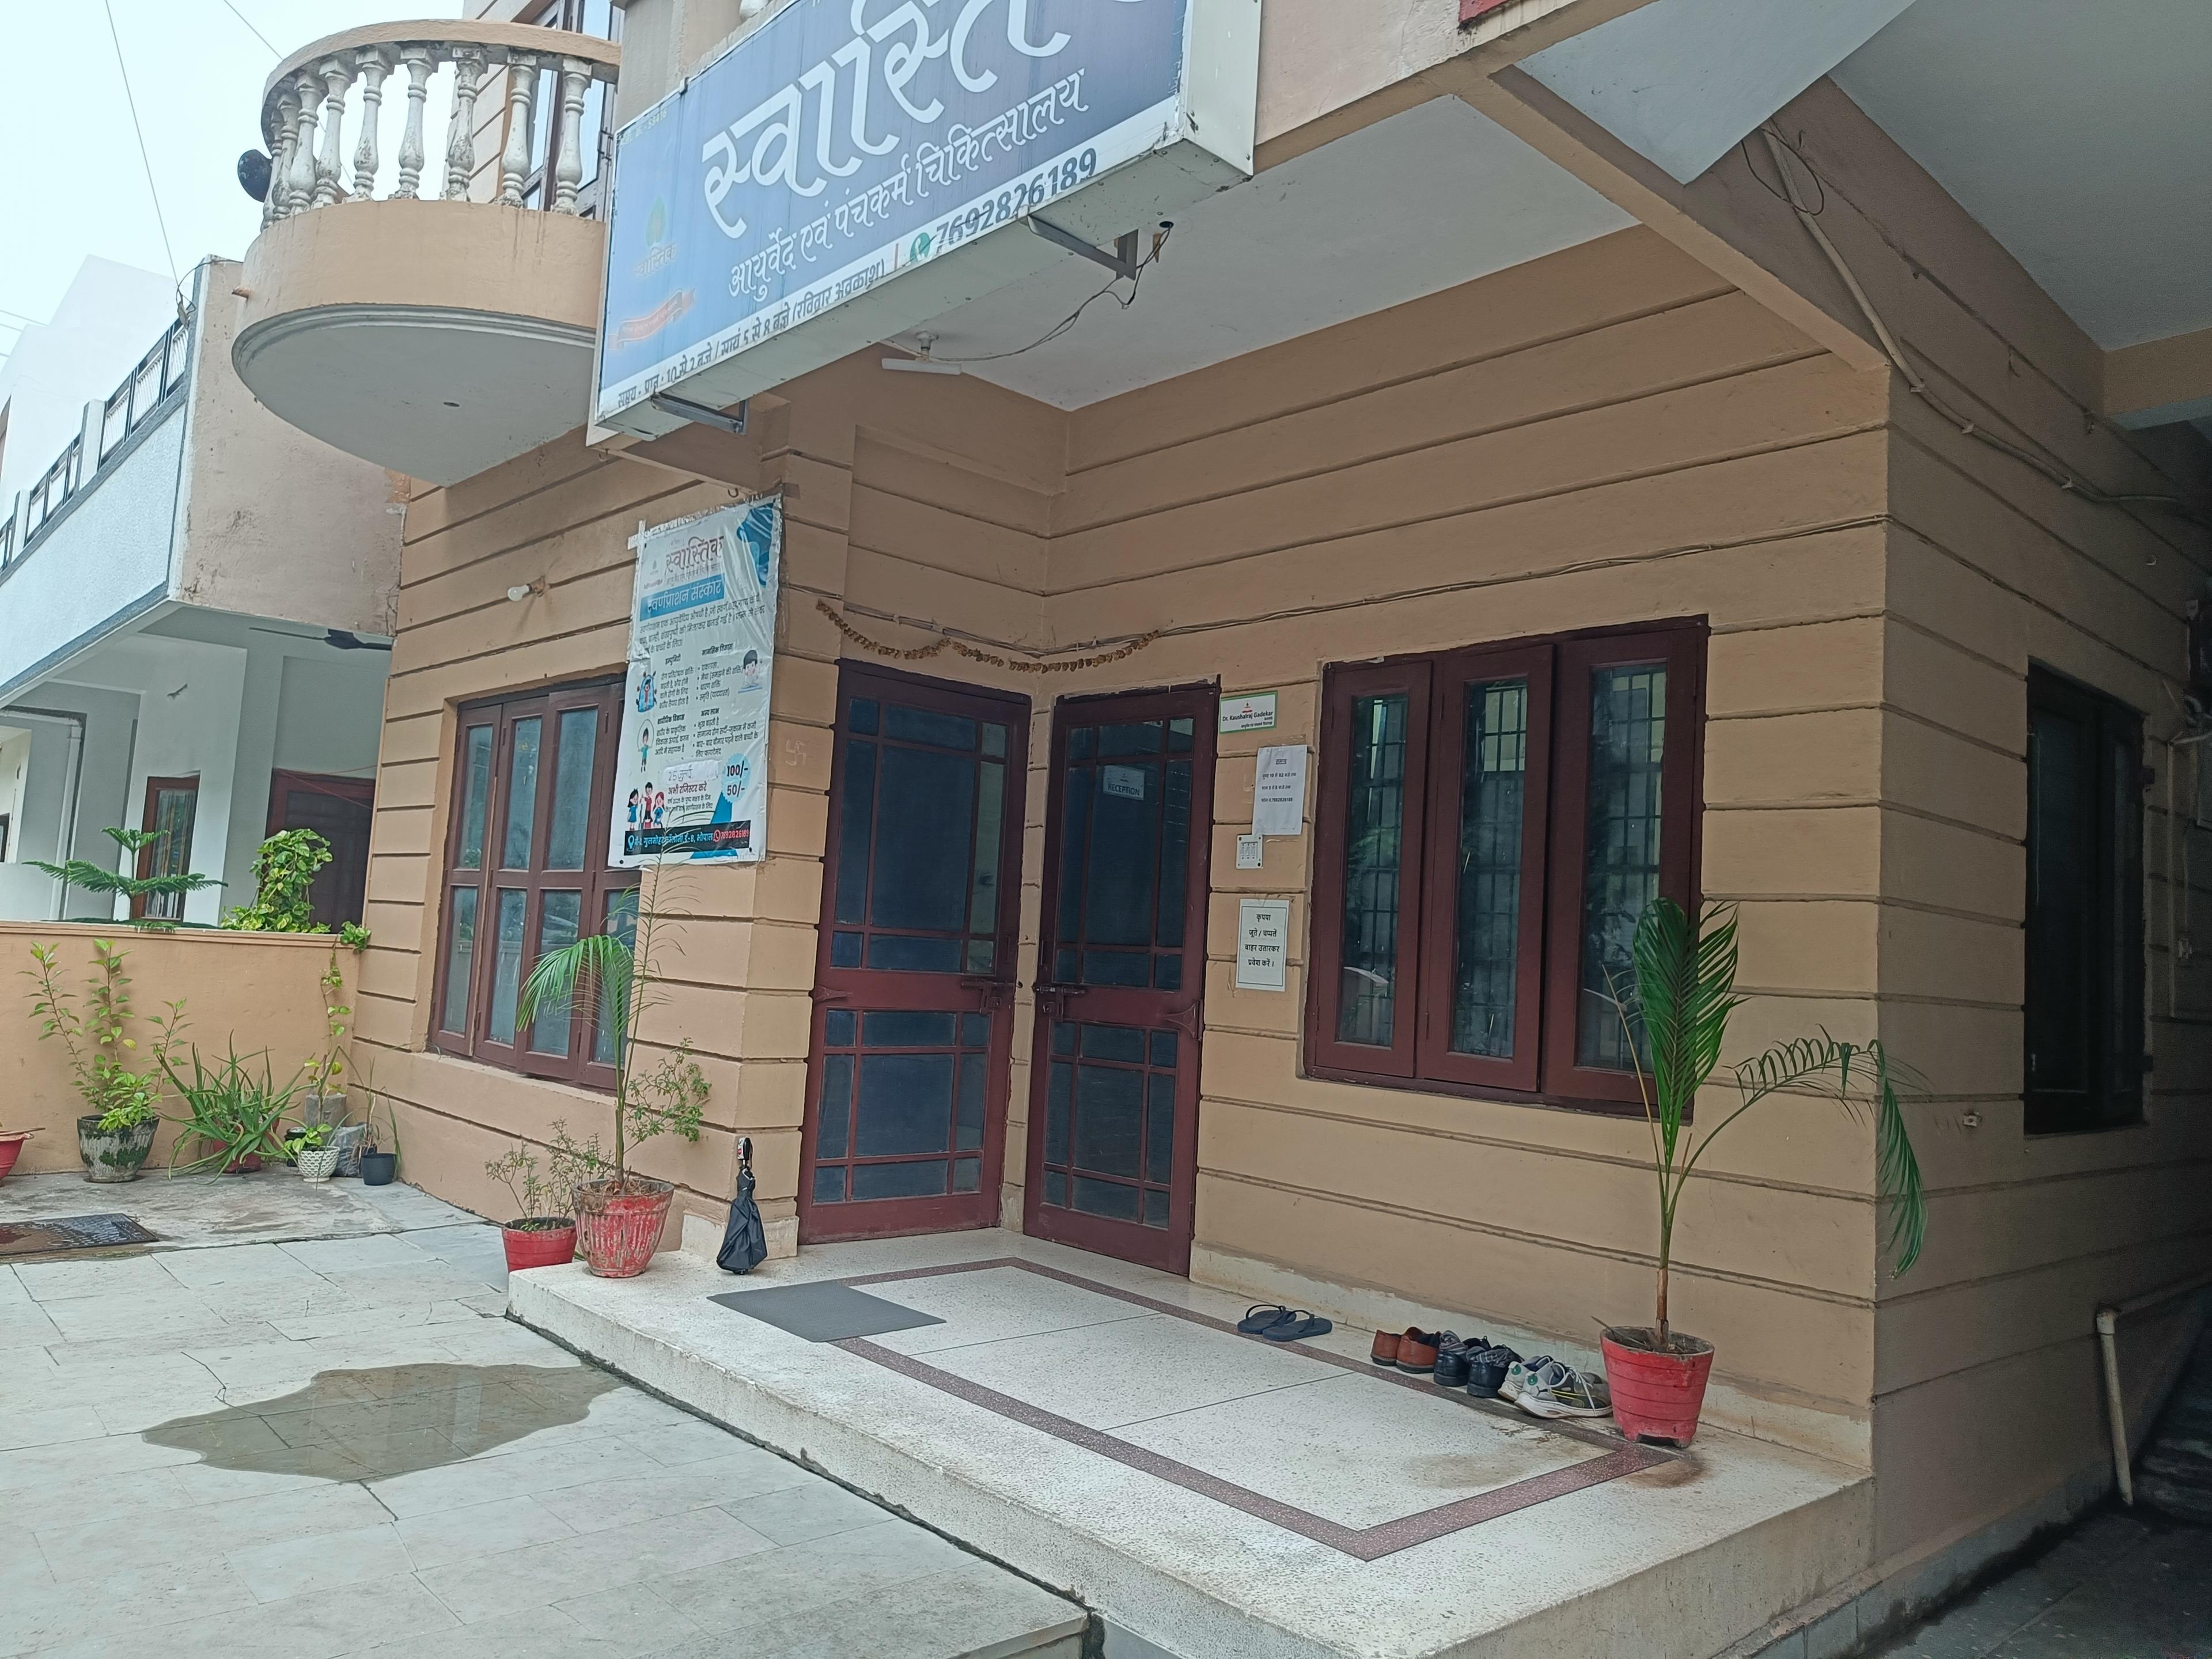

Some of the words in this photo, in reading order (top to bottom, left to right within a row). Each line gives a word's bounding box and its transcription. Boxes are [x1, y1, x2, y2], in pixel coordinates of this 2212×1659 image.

[701, 0, 1147, 238] स्वास्ति
[728, 227, 797, 302] आयुर्वेद
[800, 199, 834, 263] एवं
[834, 153, 914, 238] पंचकर्म
[915, 68, 1089, 198] चिकित्सालय
[935, 147, 1097, 254] 7692826189
[666, 366, 677, 383] 10
[679, 354, 688, 376] से
[691, 357, 695, 370] 2
[697, 342, 712, 367] बजे
[721, 328, 741, 356] सायं
[744, 329, 749, 343] 5
[752, 316, 760, 342] से
[773, 302, 791, 331] बजे
[666, 535, 724, 573] स्वास्तिक
[647, 589, 690, 613] स्वर्णप्राशन
[691, 579, 724, 601] संस्कार
[726, 760, 749, 778] 100/-
[668, 783, 679, 795] अभी
[679, 782, 698, 794] रजिस्टर
[726, 780, 745, 798] 50/-
[1108, 783, 1140, 796] RECEPTION
[696, 831, 714, 842] भोपाल
[1256, 914, 1271, 922] कृपया
[1248, 927, 1257, 938] जूते
[1248, 957, 1261, 966] प्रवेश
